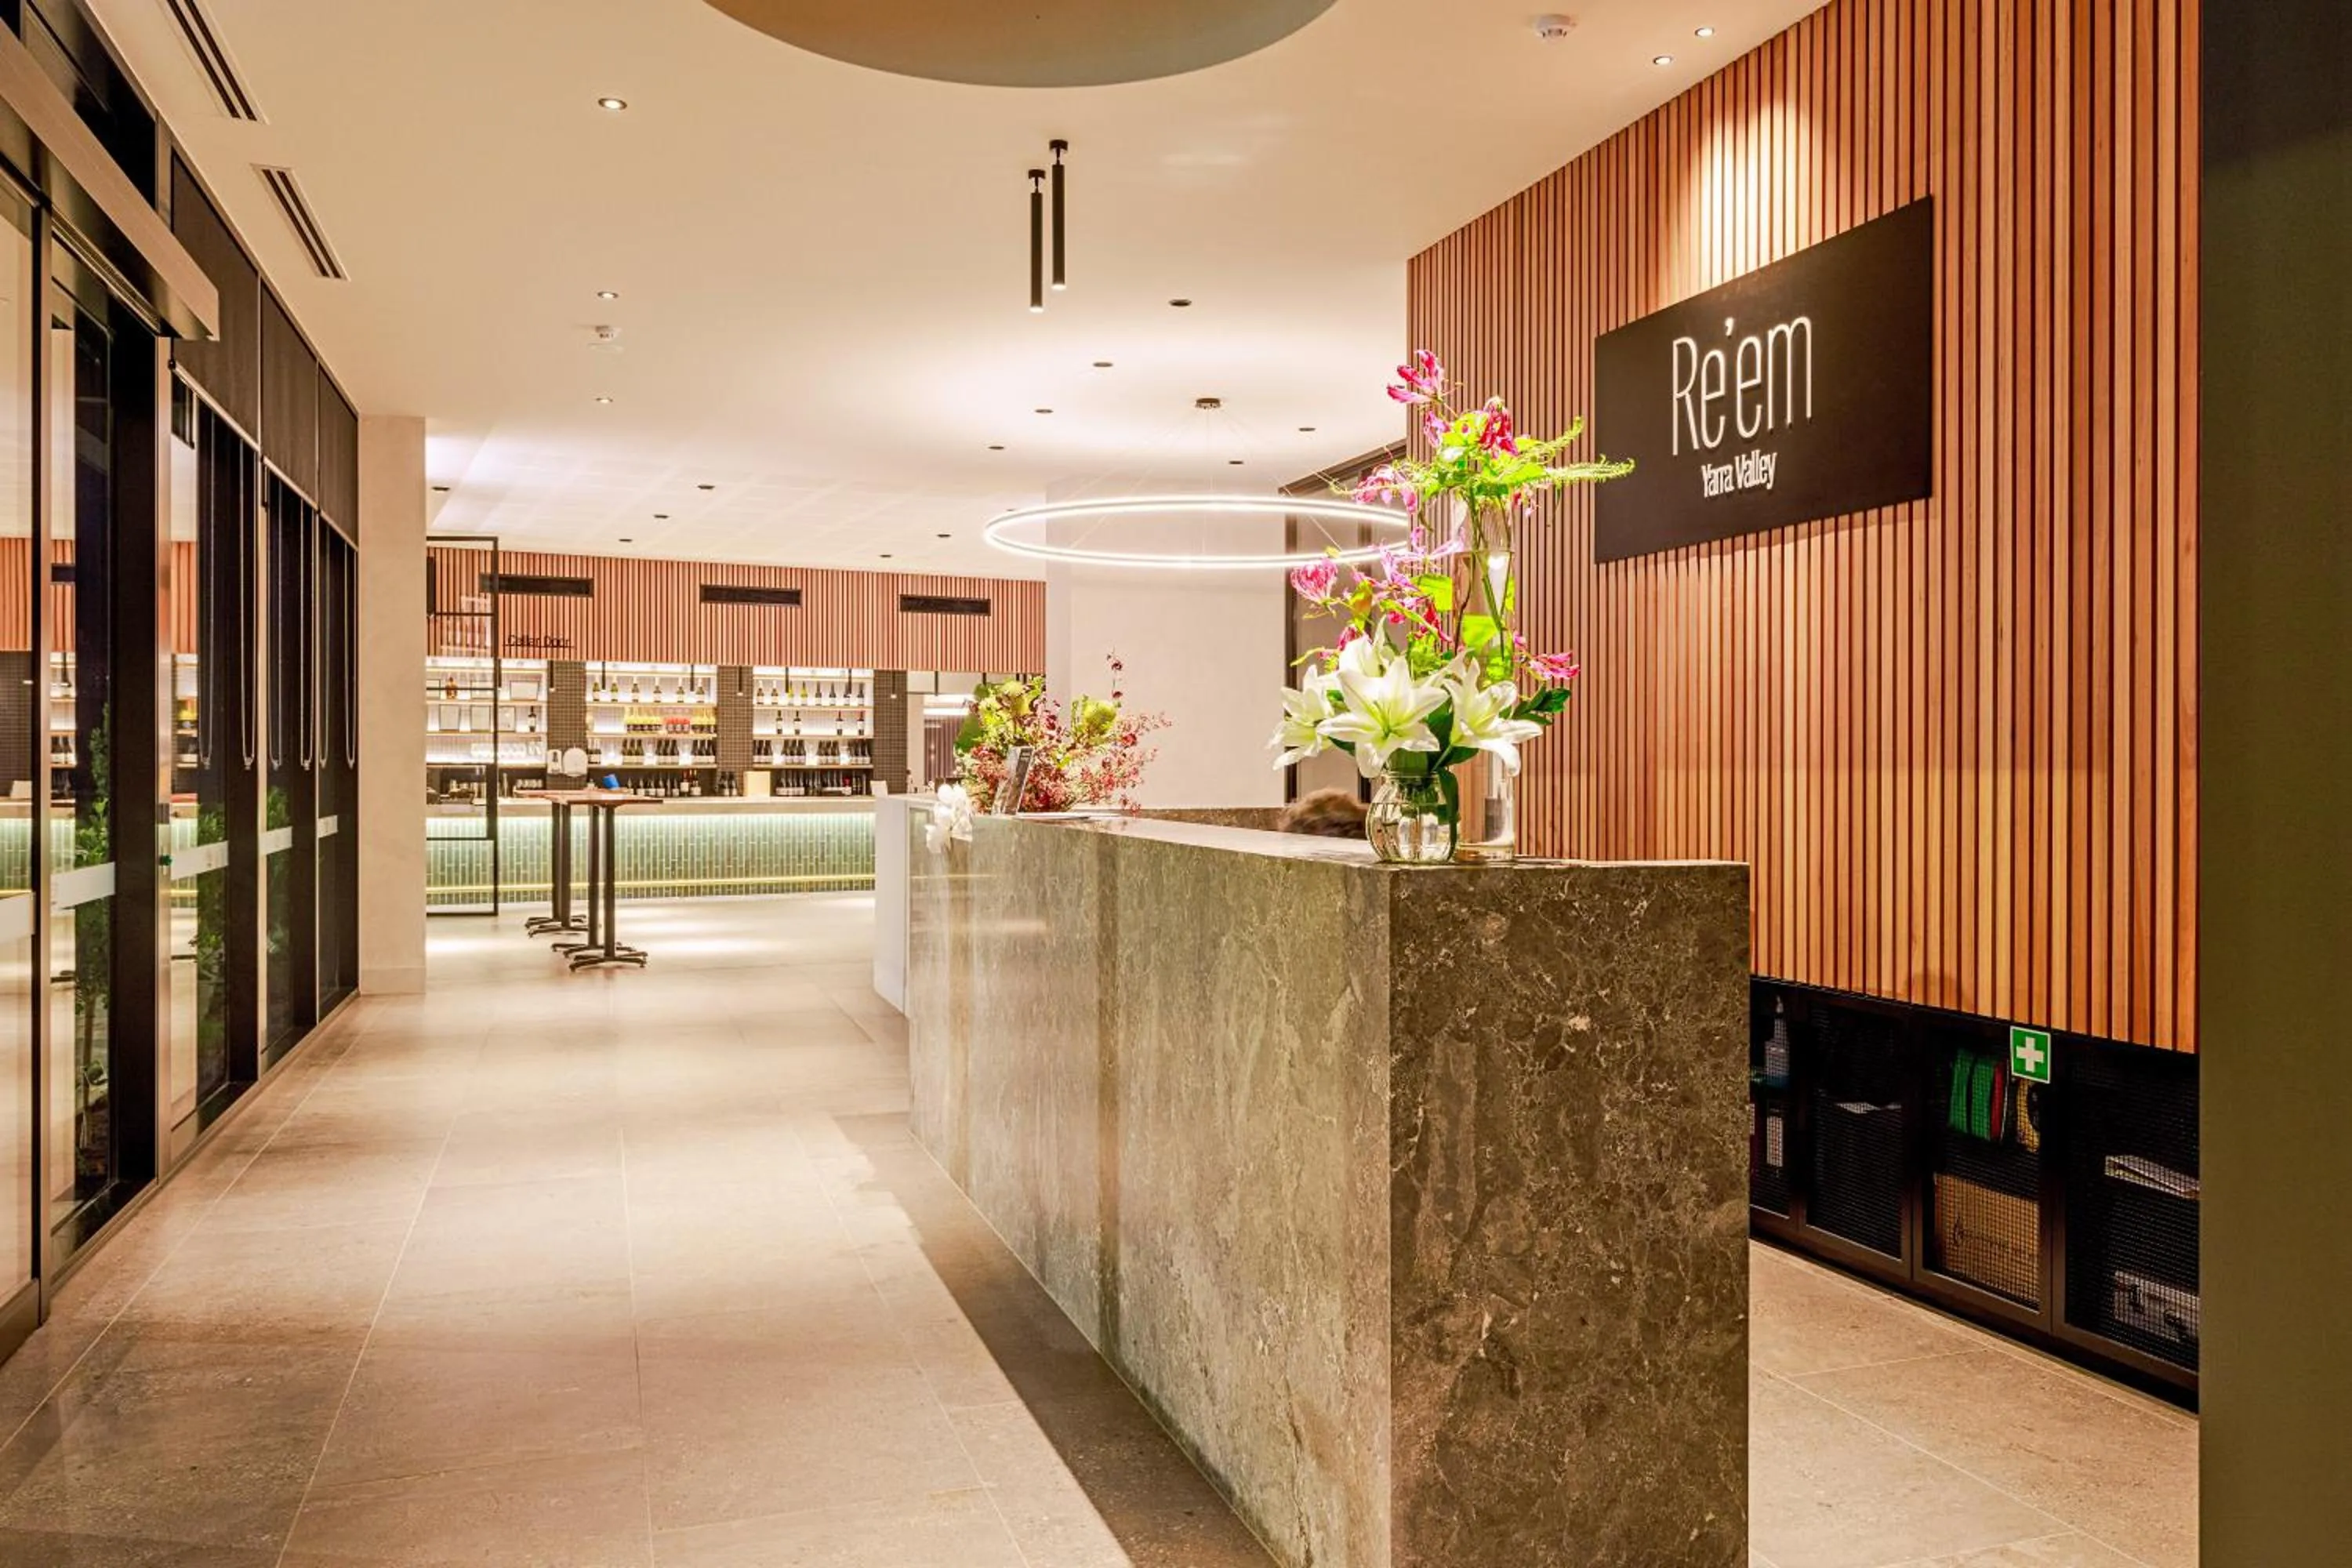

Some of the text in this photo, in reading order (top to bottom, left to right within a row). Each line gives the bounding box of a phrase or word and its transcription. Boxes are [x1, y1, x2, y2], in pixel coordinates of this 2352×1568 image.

[1671, 315, 1813, 456] Re'em
[1700, 449, 1778, 499] Yarra Valley
